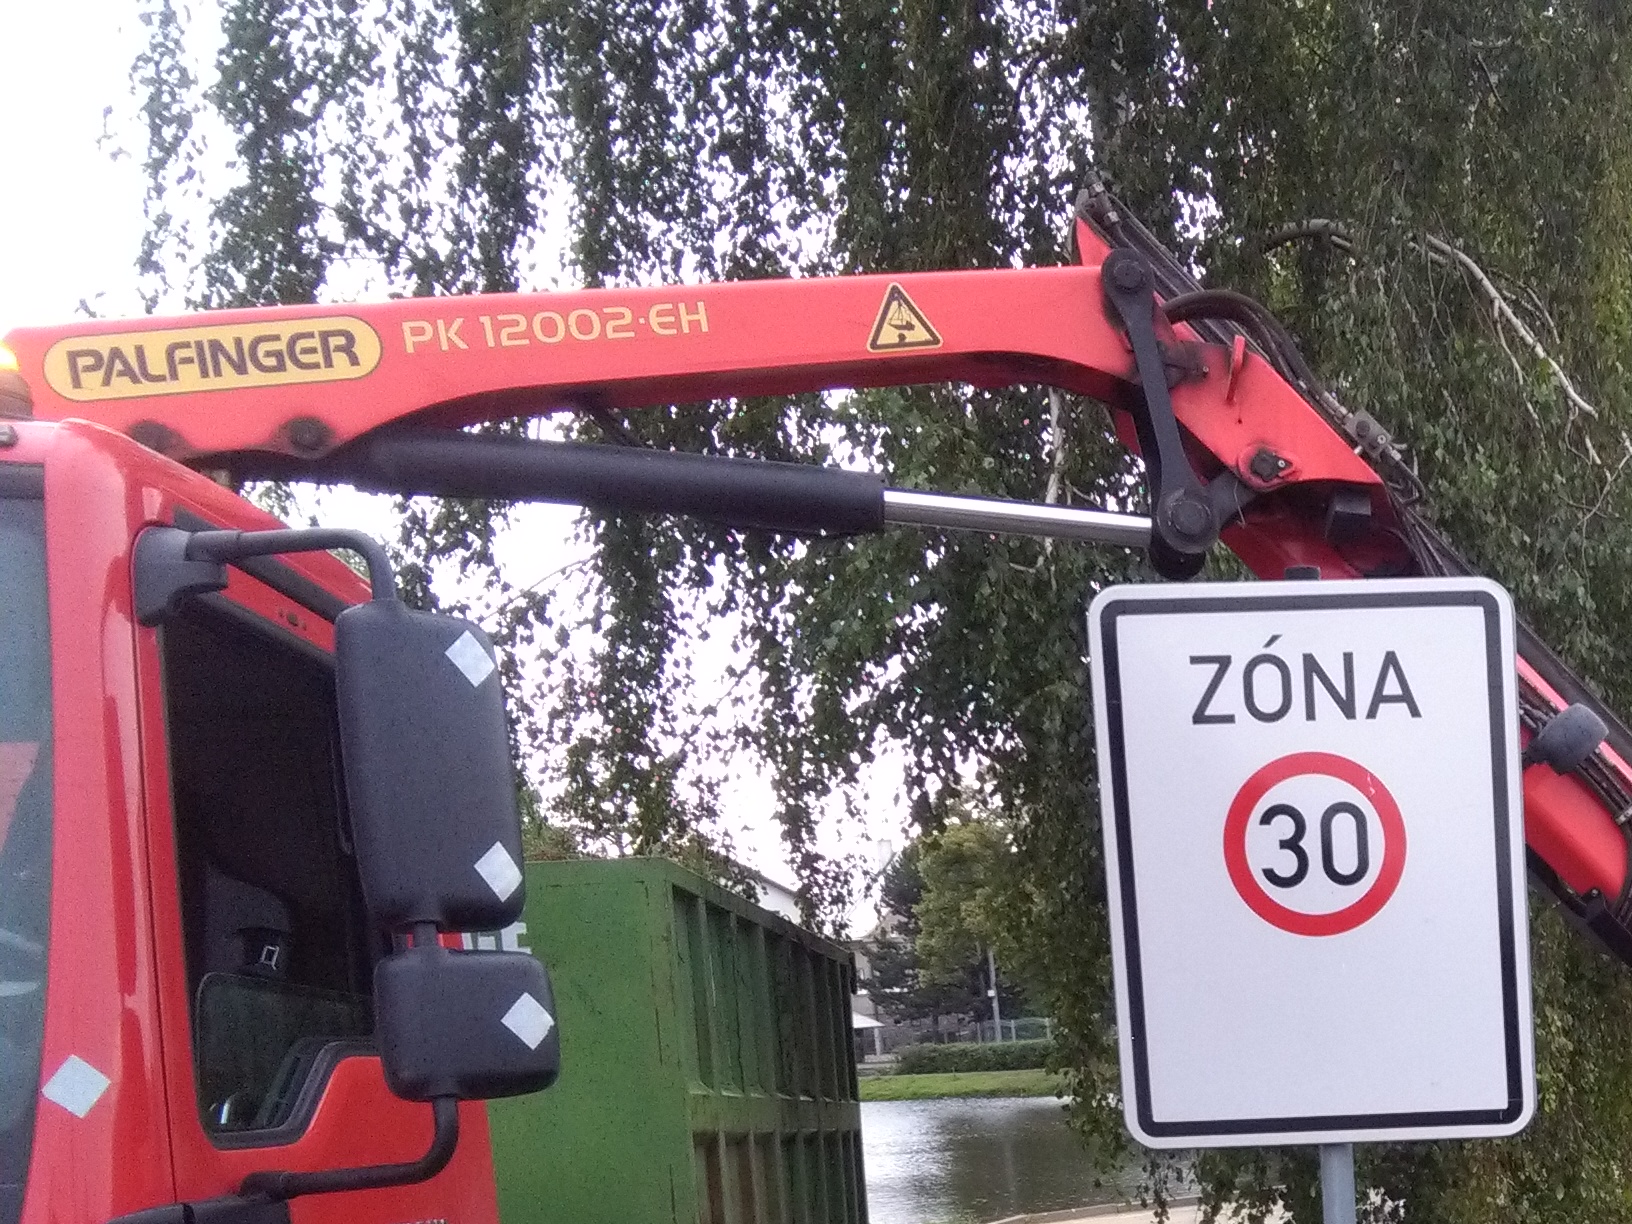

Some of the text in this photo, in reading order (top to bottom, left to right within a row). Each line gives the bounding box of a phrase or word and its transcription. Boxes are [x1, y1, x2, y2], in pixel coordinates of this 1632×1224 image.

[66, 329, 360, 389] PALFINGER
[401, 317, 469, 353] PK
[1189, 634, 1422, 725] ZÓNA
[1258, 801, 1370, 888] 30
